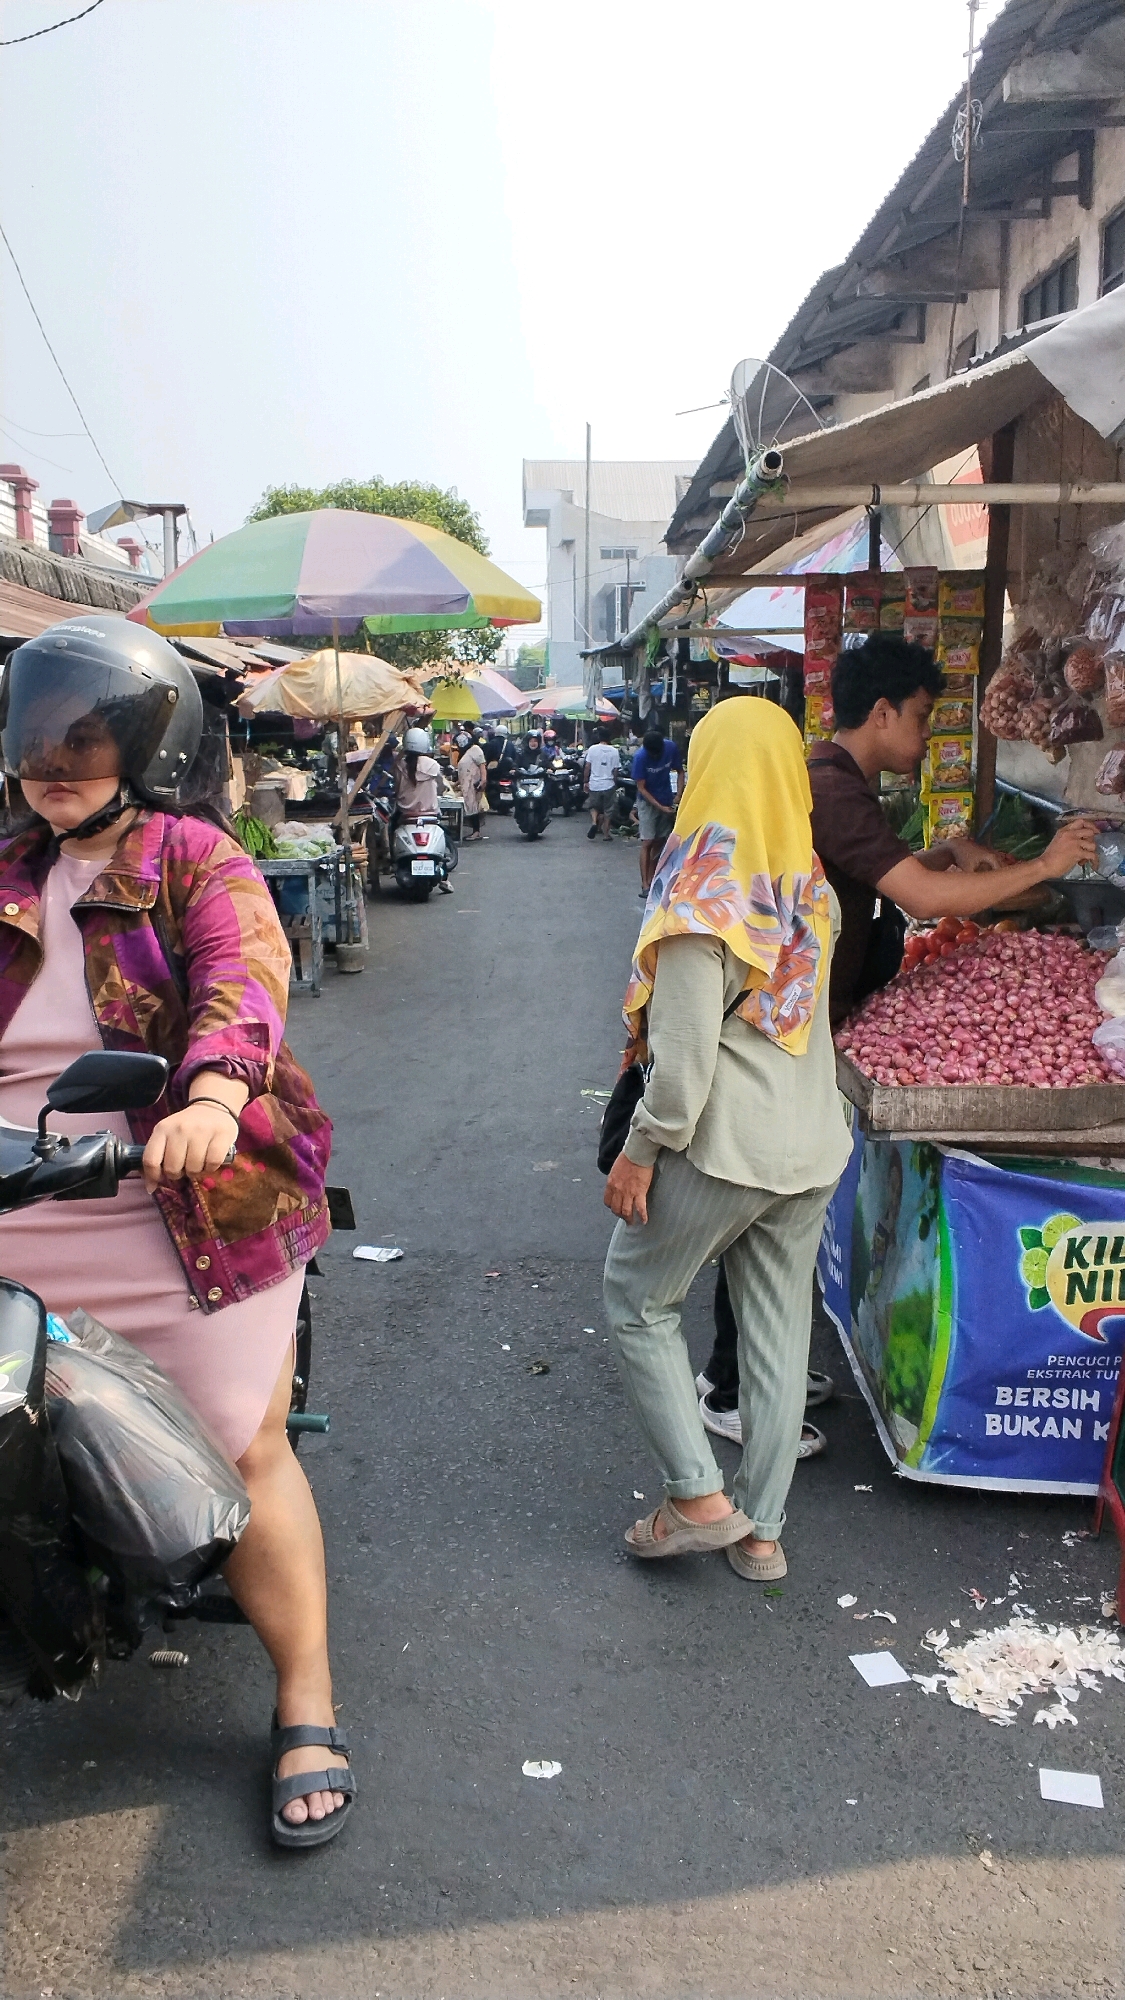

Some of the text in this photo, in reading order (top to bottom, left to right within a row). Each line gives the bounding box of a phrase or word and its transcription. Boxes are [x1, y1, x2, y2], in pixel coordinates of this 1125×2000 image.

[1047, 1355, 1110, 1366] PENCUCI
[1027, 1369, 1091, 1379] EKSTRAK
[995, 1386, 1100, 1412] BERSIH
[985, 1413, 1082, 1439] BUKAN
